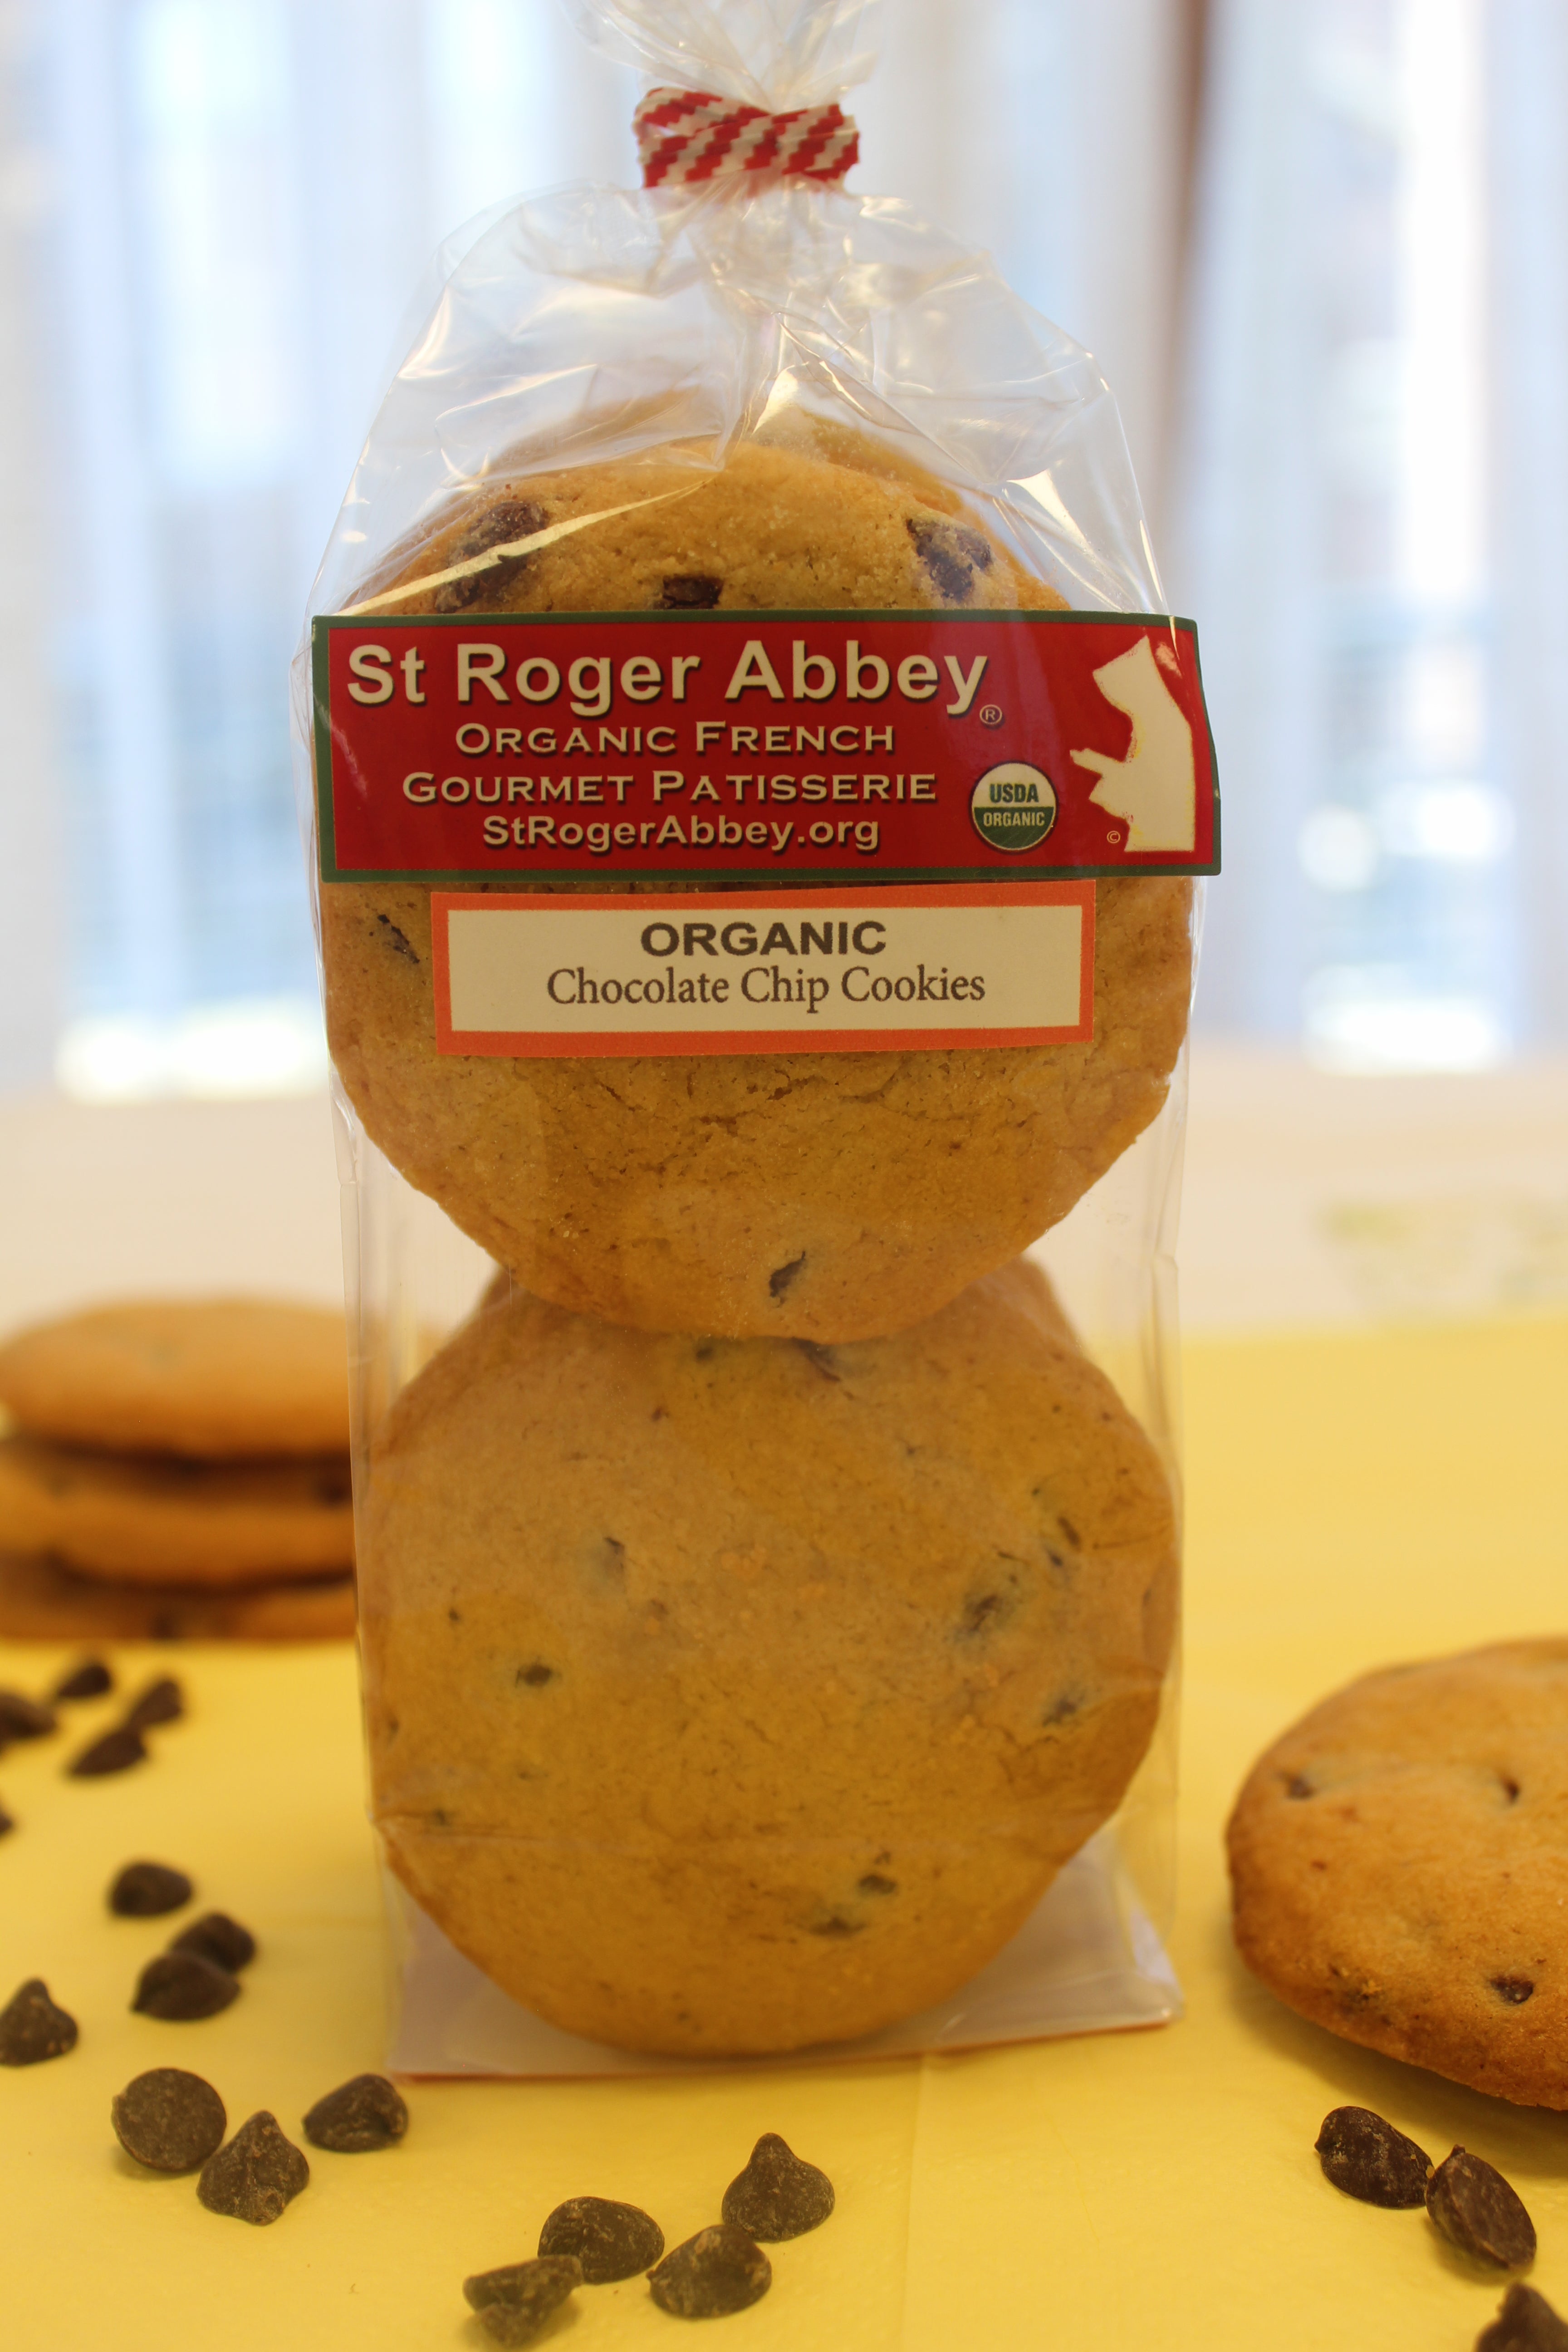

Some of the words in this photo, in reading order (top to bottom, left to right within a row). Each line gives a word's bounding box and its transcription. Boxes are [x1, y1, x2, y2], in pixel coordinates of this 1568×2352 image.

[348, 644, 426, 704] St
[457, 640, 701, 716] Roger
[725, 640, 988, 715] Abbey
[456, 723, 676, 754] ORGANIC
[696, 720, 893, 752] FRENCH
[402, 772, 633, 803] GOURMET
[652, 770, 936, 801] PATISSERIE
[990, 784, 1039, 803] USDA
[483, 815, 878, 853] StRogerAbbey.org
[983, 812, 1045, 827] ORGANIC
[641, 921, 886, 956] ORGANIC
[547, 966, 730, 1004] Chocolate
[741, 965, 830, 1014] Chip
[841, 964, 986, 1002] Cookies
